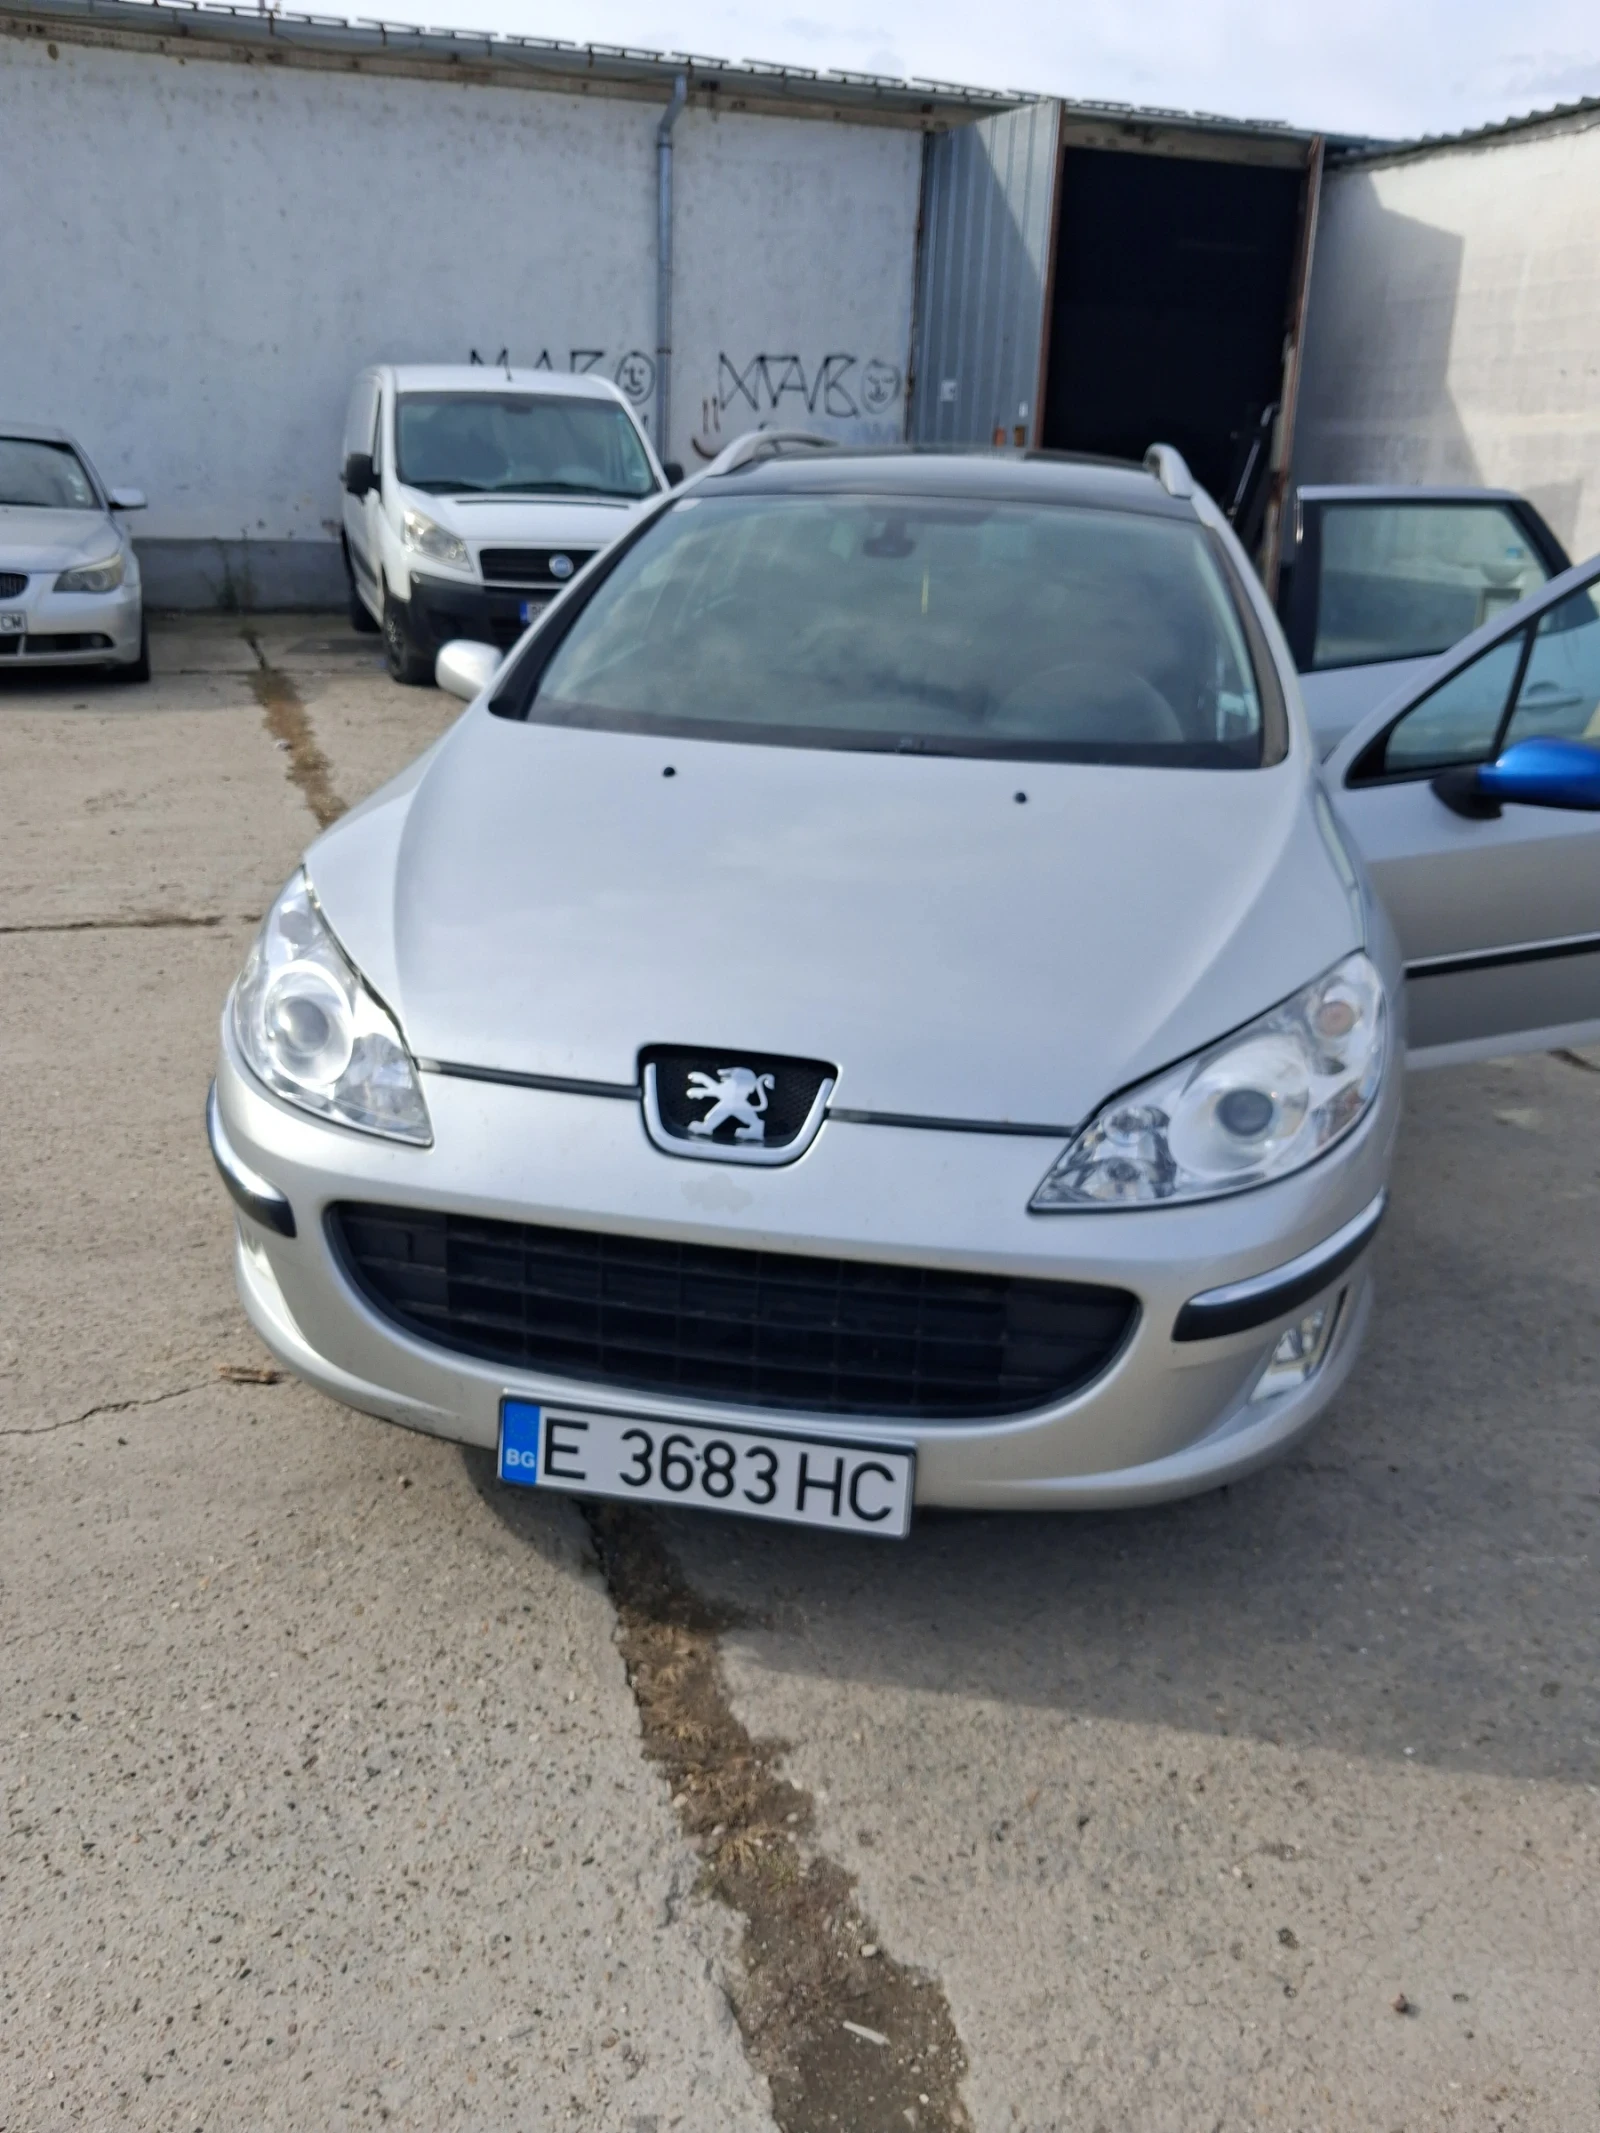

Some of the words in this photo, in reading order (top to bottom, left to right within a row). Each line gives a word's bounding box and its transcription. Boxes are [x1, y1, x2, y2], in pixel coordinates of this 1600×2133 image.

[505, 1447, 536, 1469] BG
[543, 1417, 590, 1481] E
[619, 1428, 779, 1505] 3683
[796, 1452, 896, 1523] HC
